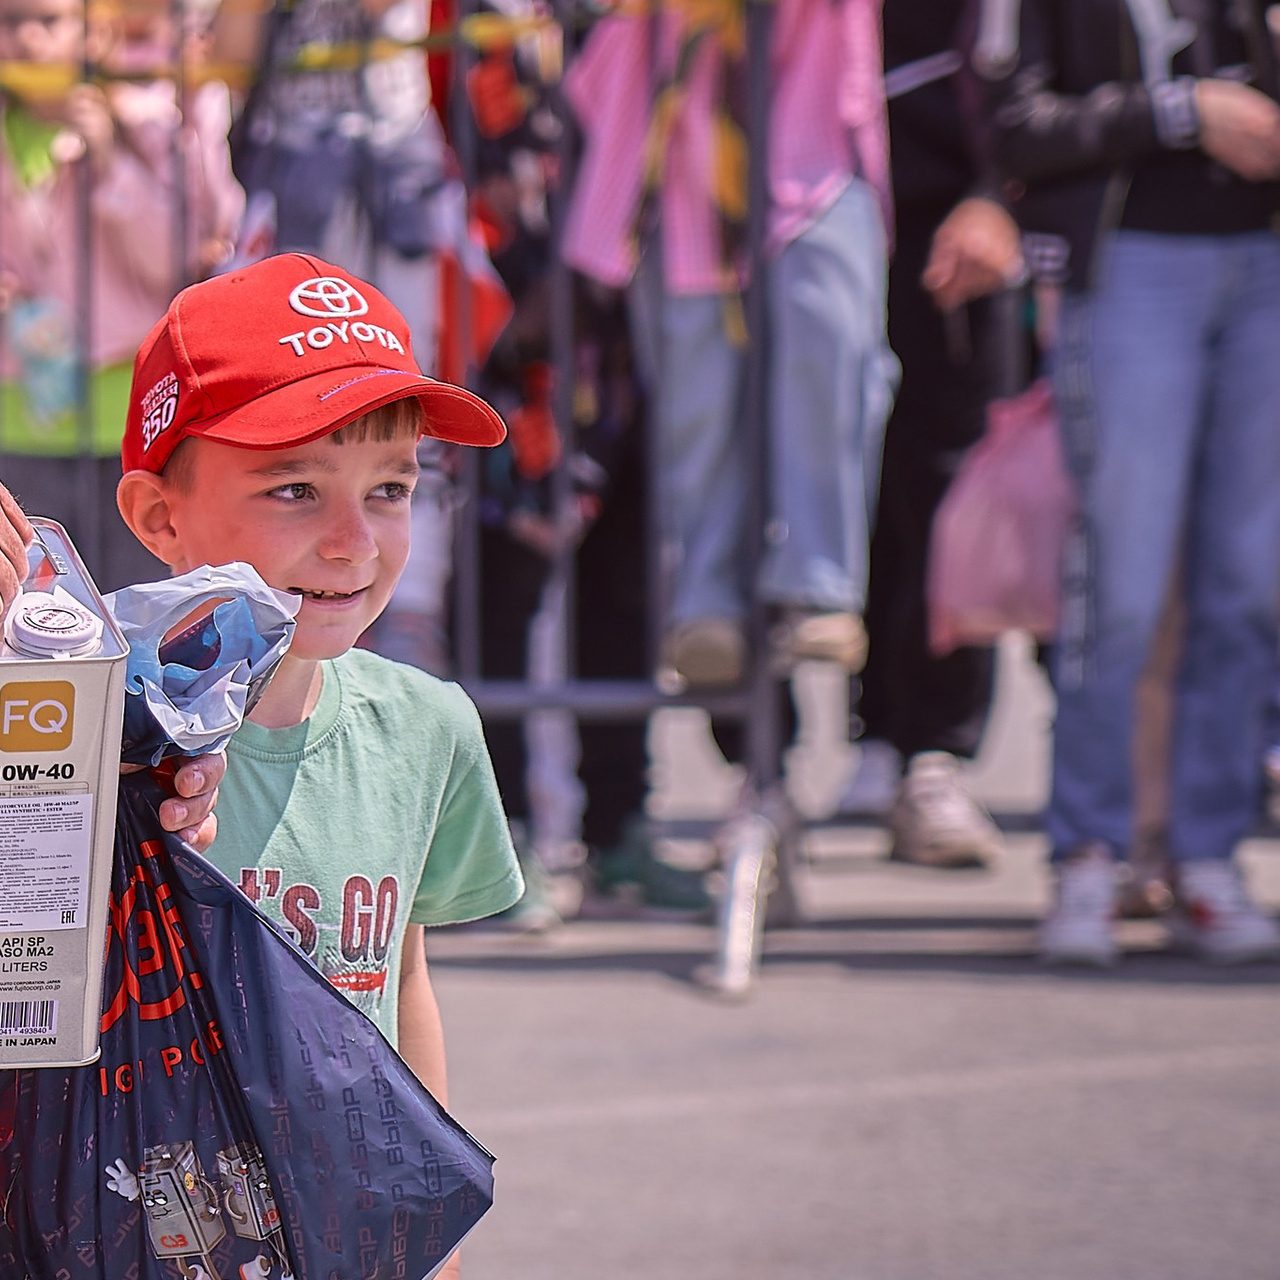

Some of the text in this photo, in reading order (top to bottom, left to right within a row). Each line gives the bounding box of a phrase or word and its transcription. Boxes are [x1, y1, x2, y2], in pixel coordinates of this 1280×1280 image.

[279, 320, 404, 356] TOYOTA
[141, 372, 177, 410] TOYOTA
[142, 397, 177, 451] 350
[3, 699, 68, 735] FQ
[340, 874, 398, 964] GO
[2, 936, 45, 948] API SP
[26, 946, 54, 957] MA2
[2, 961, 48, 972] LITERS
[5, 1038, 17, 1047] IN
[20, 1037, 57, 1046] JAPAN
